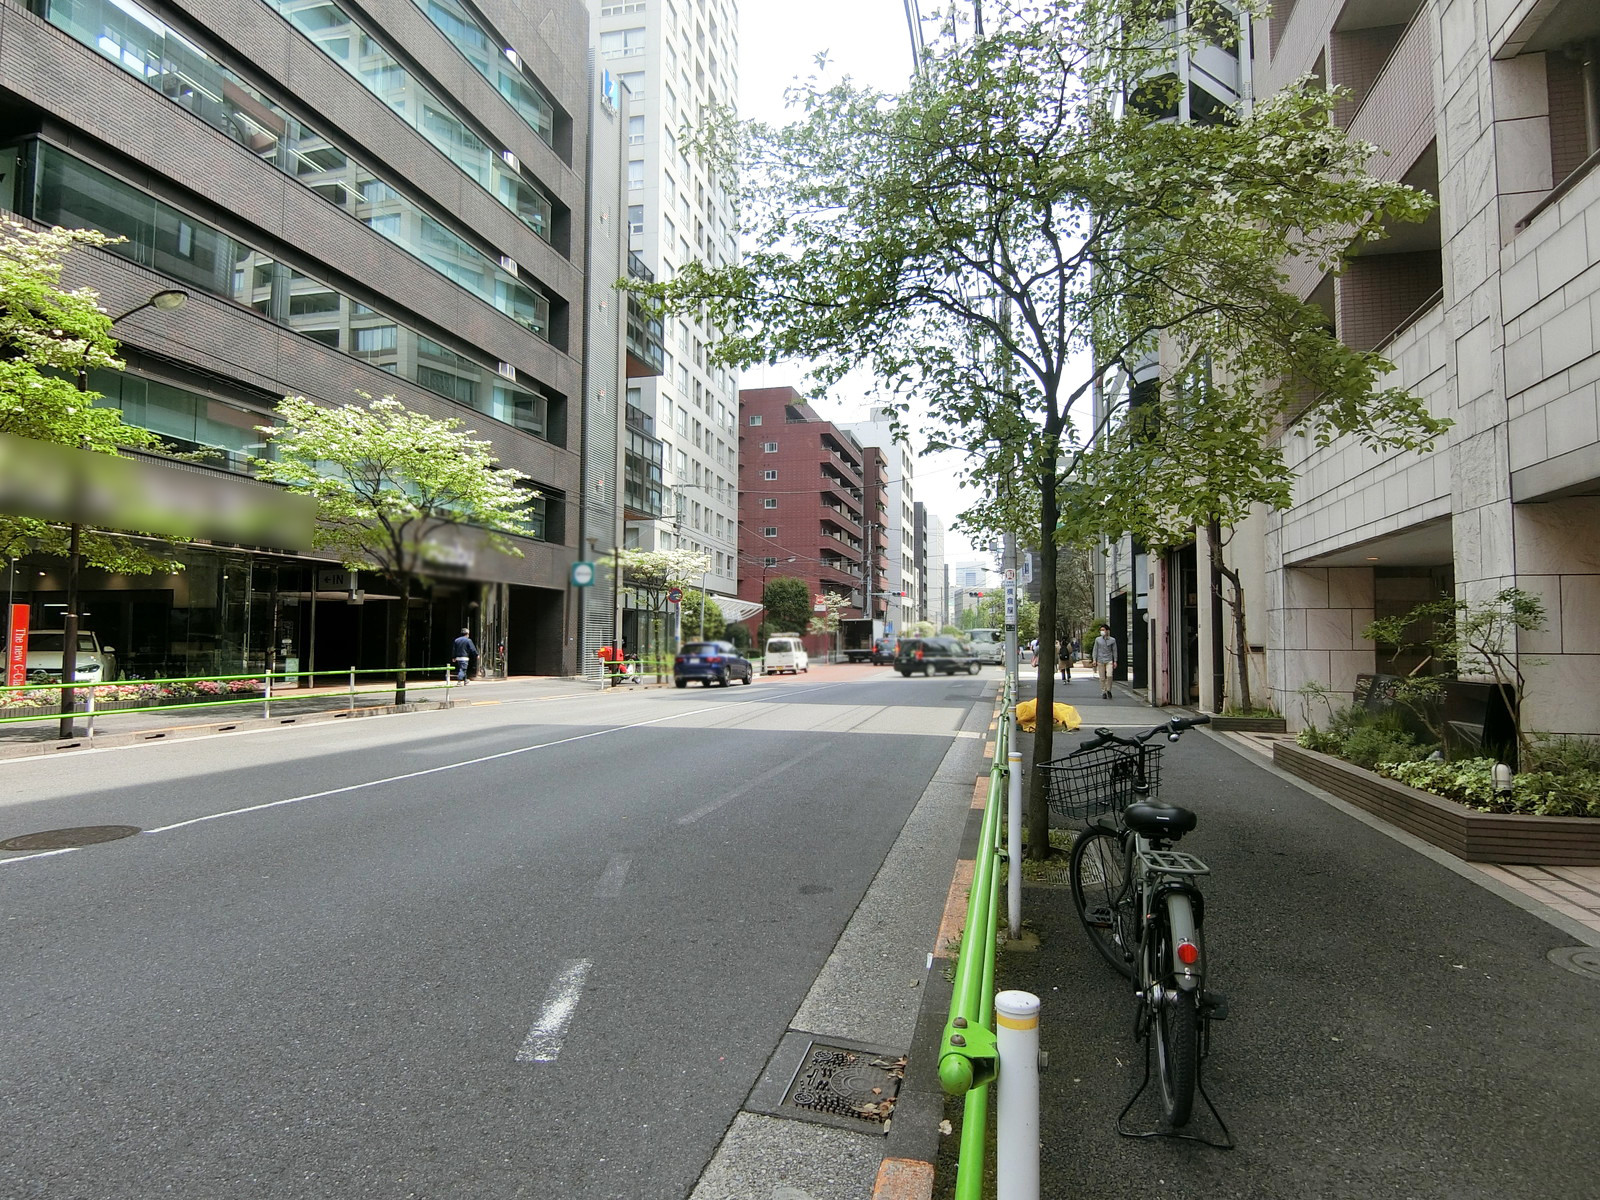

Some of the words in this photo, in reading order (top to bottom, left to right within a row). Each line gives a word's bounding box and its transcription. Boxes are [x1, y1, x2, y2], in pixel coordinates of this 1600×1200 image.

[333, 574, 343, 584] IN
[15, 628, 26, 643] The
[14, 645, 23, 661] new
